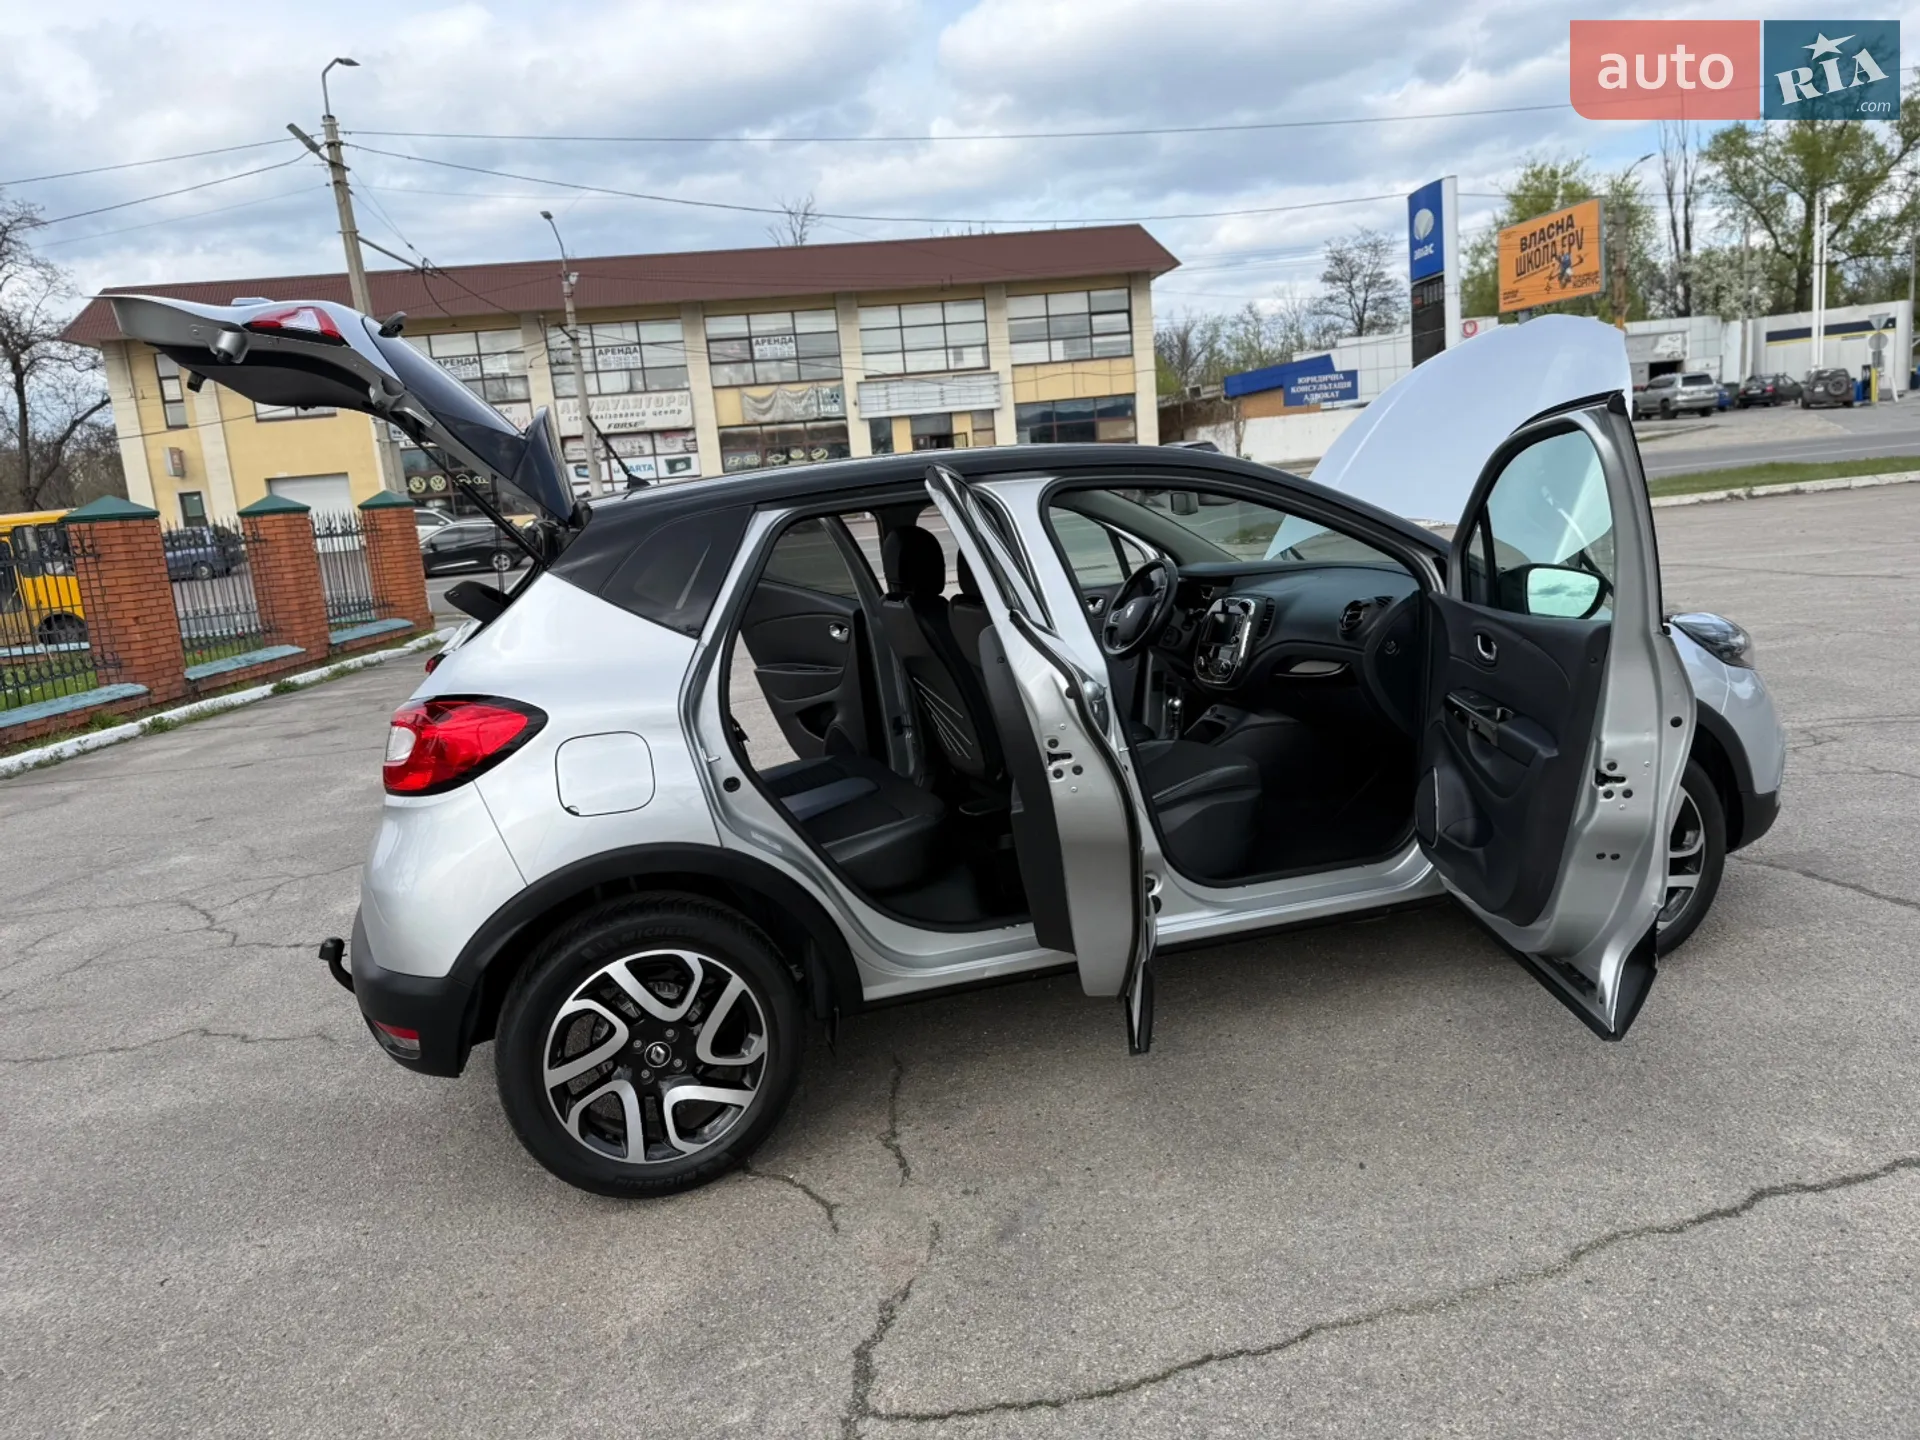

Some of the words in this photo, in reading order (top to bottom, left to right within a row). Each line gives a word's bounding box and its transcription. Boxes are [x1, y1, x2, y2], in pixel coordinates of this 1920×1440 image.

[1520, 214, 1575, 253] ВЛАСНА
[1515, 240, 1557, 277] ШКОЛА
[754, 336, 794, 346] АРЕНДА
[598, 346, 639, 356] АРЕНДА
[436, 357, 479, 366] АРЕНДА
[1297, 373, 1344, 384] ЮРИДИЧНА
[1290, 381, 1352, 394] КОНСУЛЬТАЦІЯ
[1303, 391, 1340, 401] АДВОКАТ
[652, 408, 683, 417] центр
